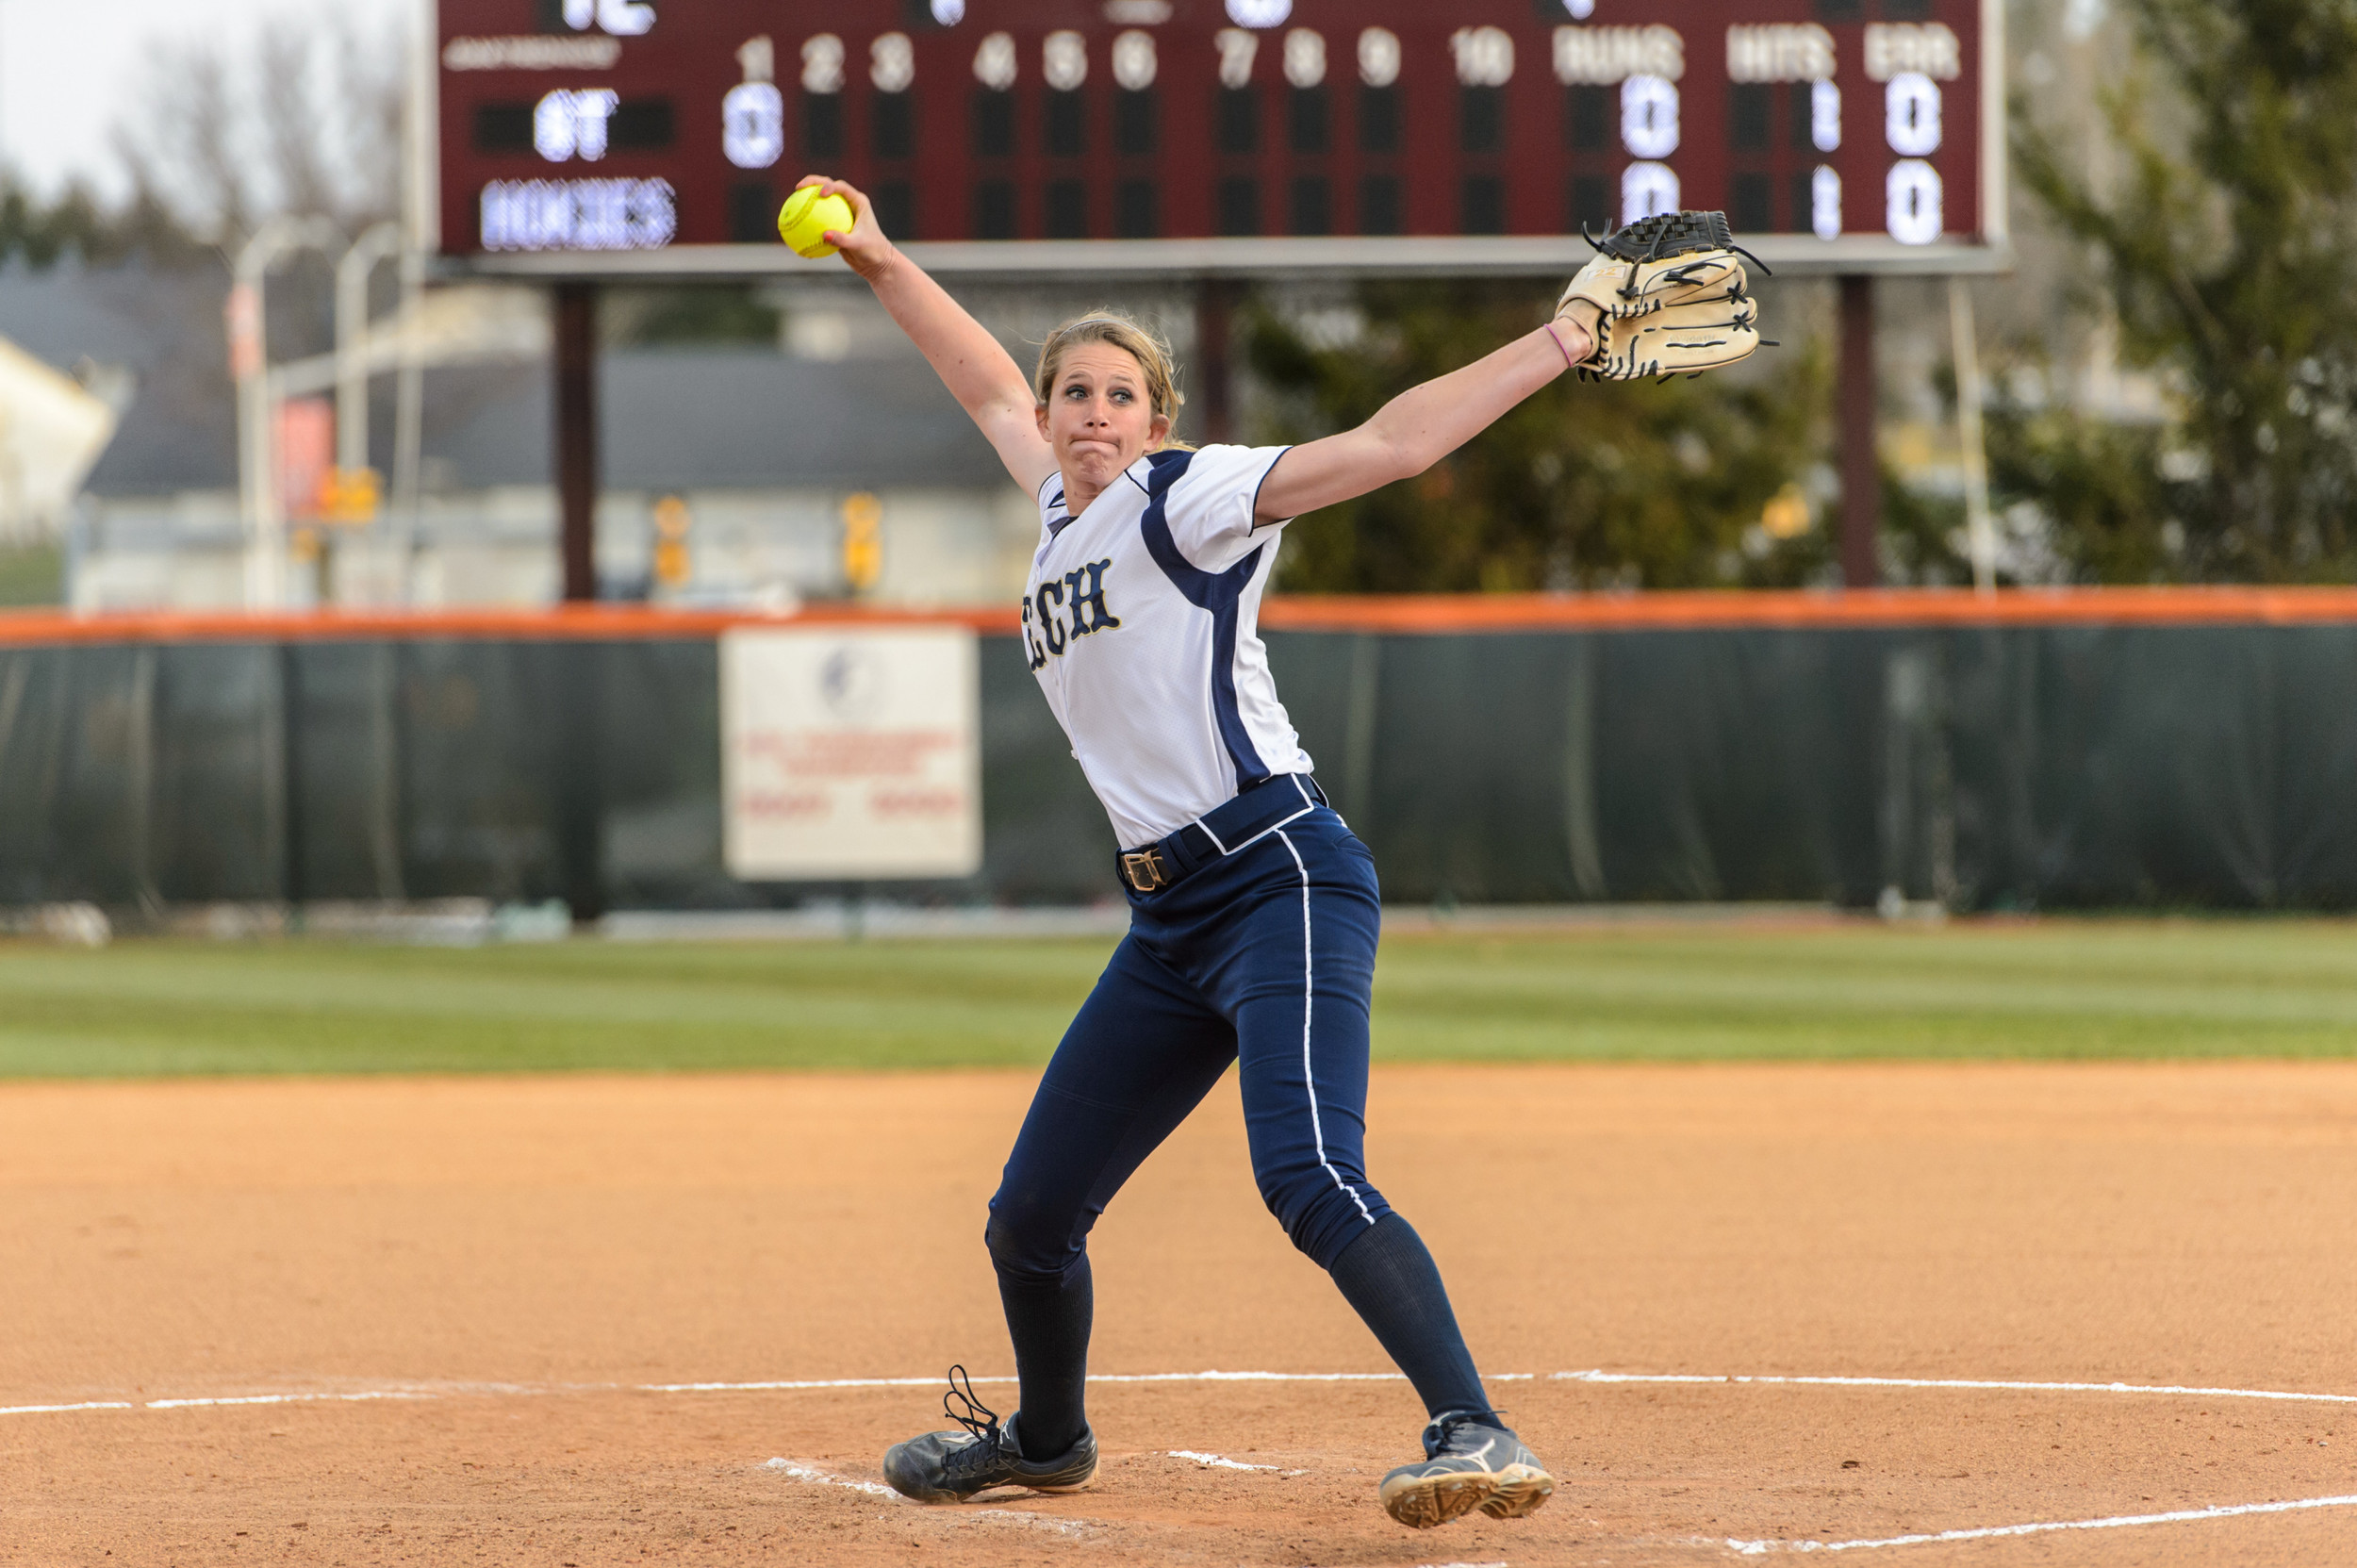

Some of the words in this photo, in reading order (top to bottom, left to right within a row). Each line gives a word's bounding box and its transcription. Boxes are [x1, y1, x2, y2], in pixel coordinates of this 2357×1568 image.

[736, 35, 774, 83] 1
[800, 33, 846, 92] 2
[870, 32, 915, 92] 3
[972, 30, 1017, 90] 4
[1043, 29, 1088, 91] 5
[1112, 29, 1158, 91] 6
[1214, 27, 1260, 90] 7
[1283, 26, 1327, 89] 8
[1358, 26, 1402, 88] 9
[1453, 25, 1515, 87] 10
[1552, 24, 1686, 86] RUNS
[1724, 23, 1838, 83] HITS
[1863, 22, 1962, 82] ERR
[722, 81, 783, 169] 0
[1621, 73, 1680, 159] 0
[1811, 76, 1842, 153] 1
[1885, 72, 1943, 157] 0
[1812, 164, 1842, 241] 1
[1886, 158, 1943, 245] 0
